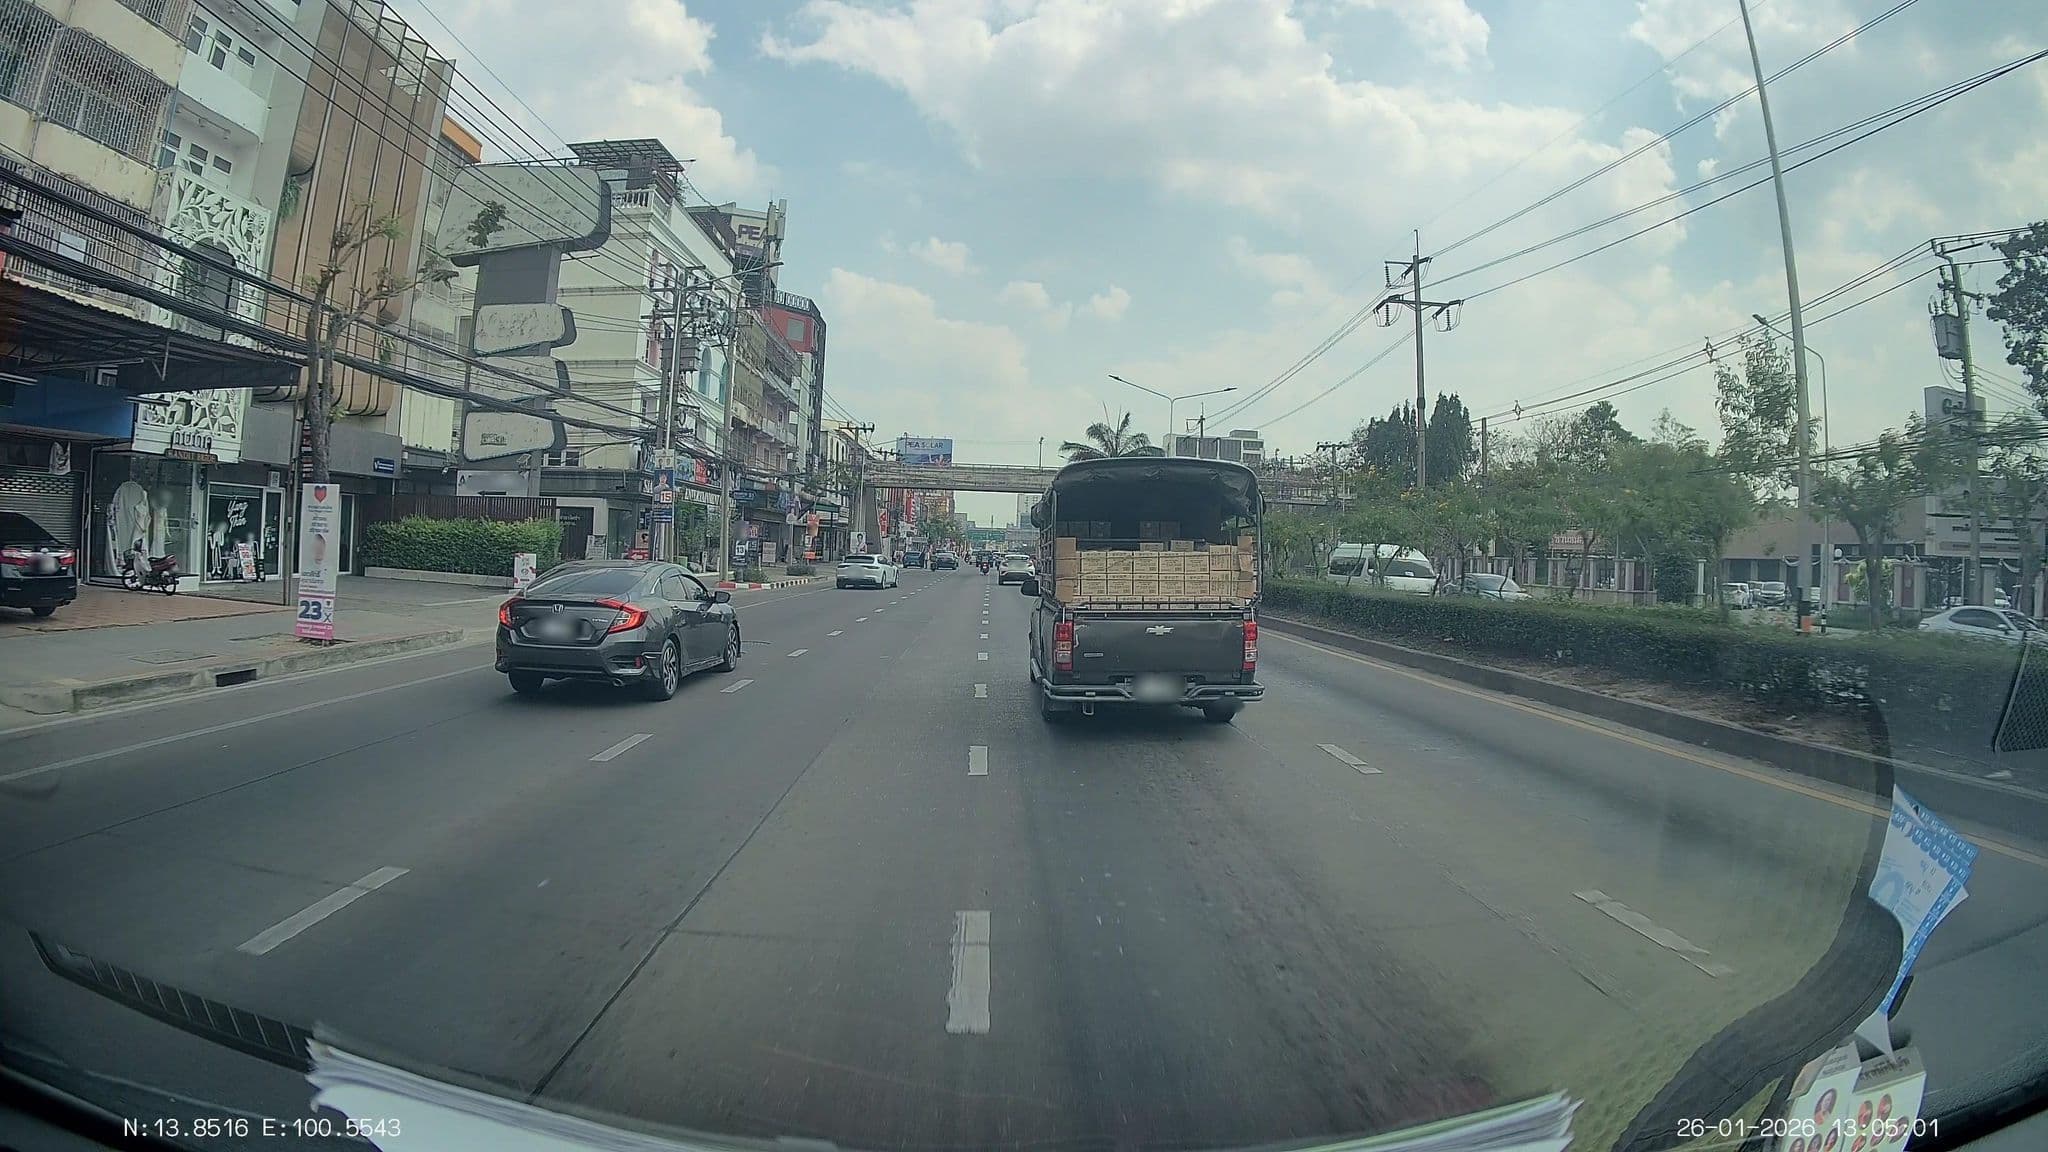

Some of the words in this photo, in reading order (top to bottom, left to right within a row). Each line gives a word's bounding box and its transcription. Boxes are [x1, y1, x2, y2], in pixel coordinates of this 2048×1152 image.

[738, 224, 768, 241] PE
[661, 492, 672, 501] 15
[299, 600, 322, 620] 23
